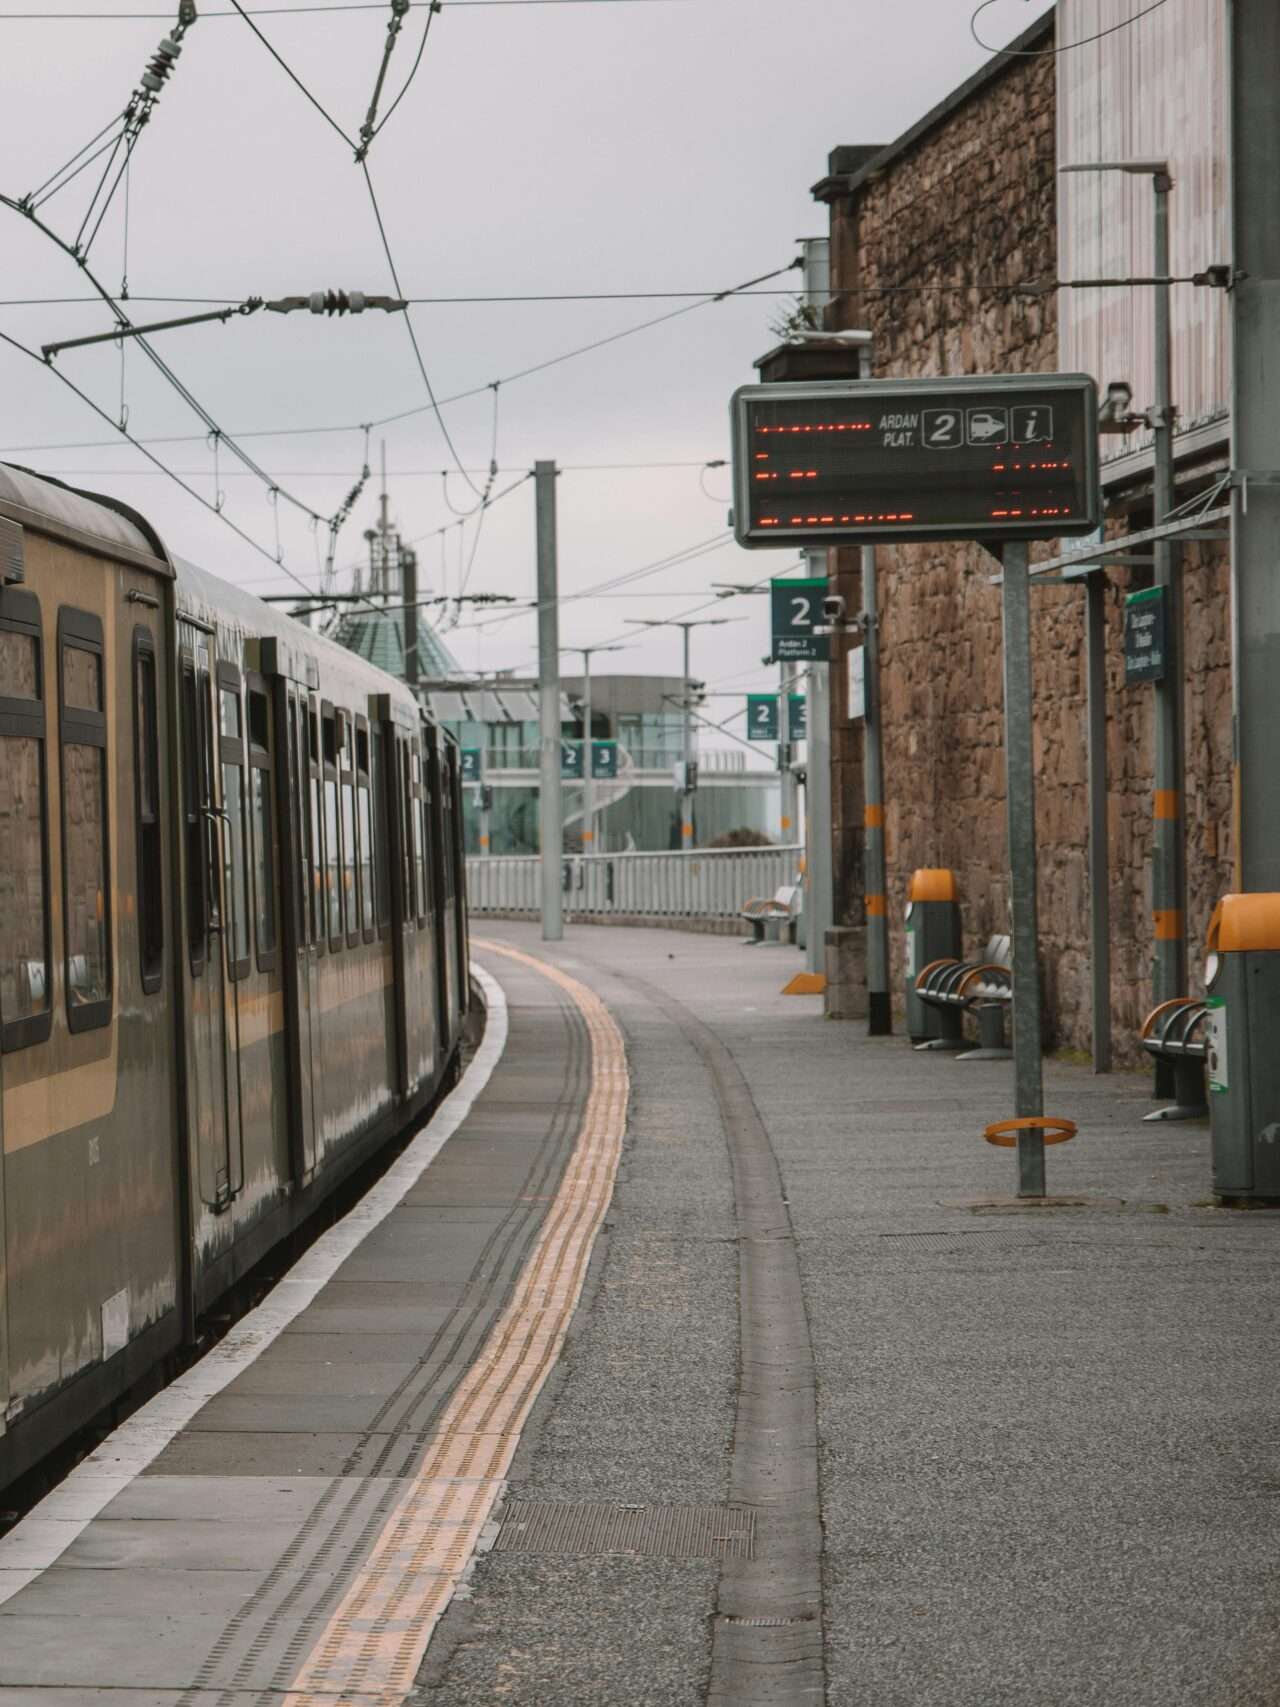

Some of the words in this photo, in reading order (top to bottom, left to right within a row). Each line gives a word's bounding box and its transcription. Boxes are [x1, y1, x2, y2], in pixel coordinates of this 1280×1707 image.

[930, 414, 956, 441] 2
[883, 431, 915, 447] PLAT.
[791, 597, 811, 626] 2
[757, 704, 770, 722] 2
[463, 756, 473, 769] 2
[566, 751, 576, 764] 2
[600, 750, 610, 763] 3
